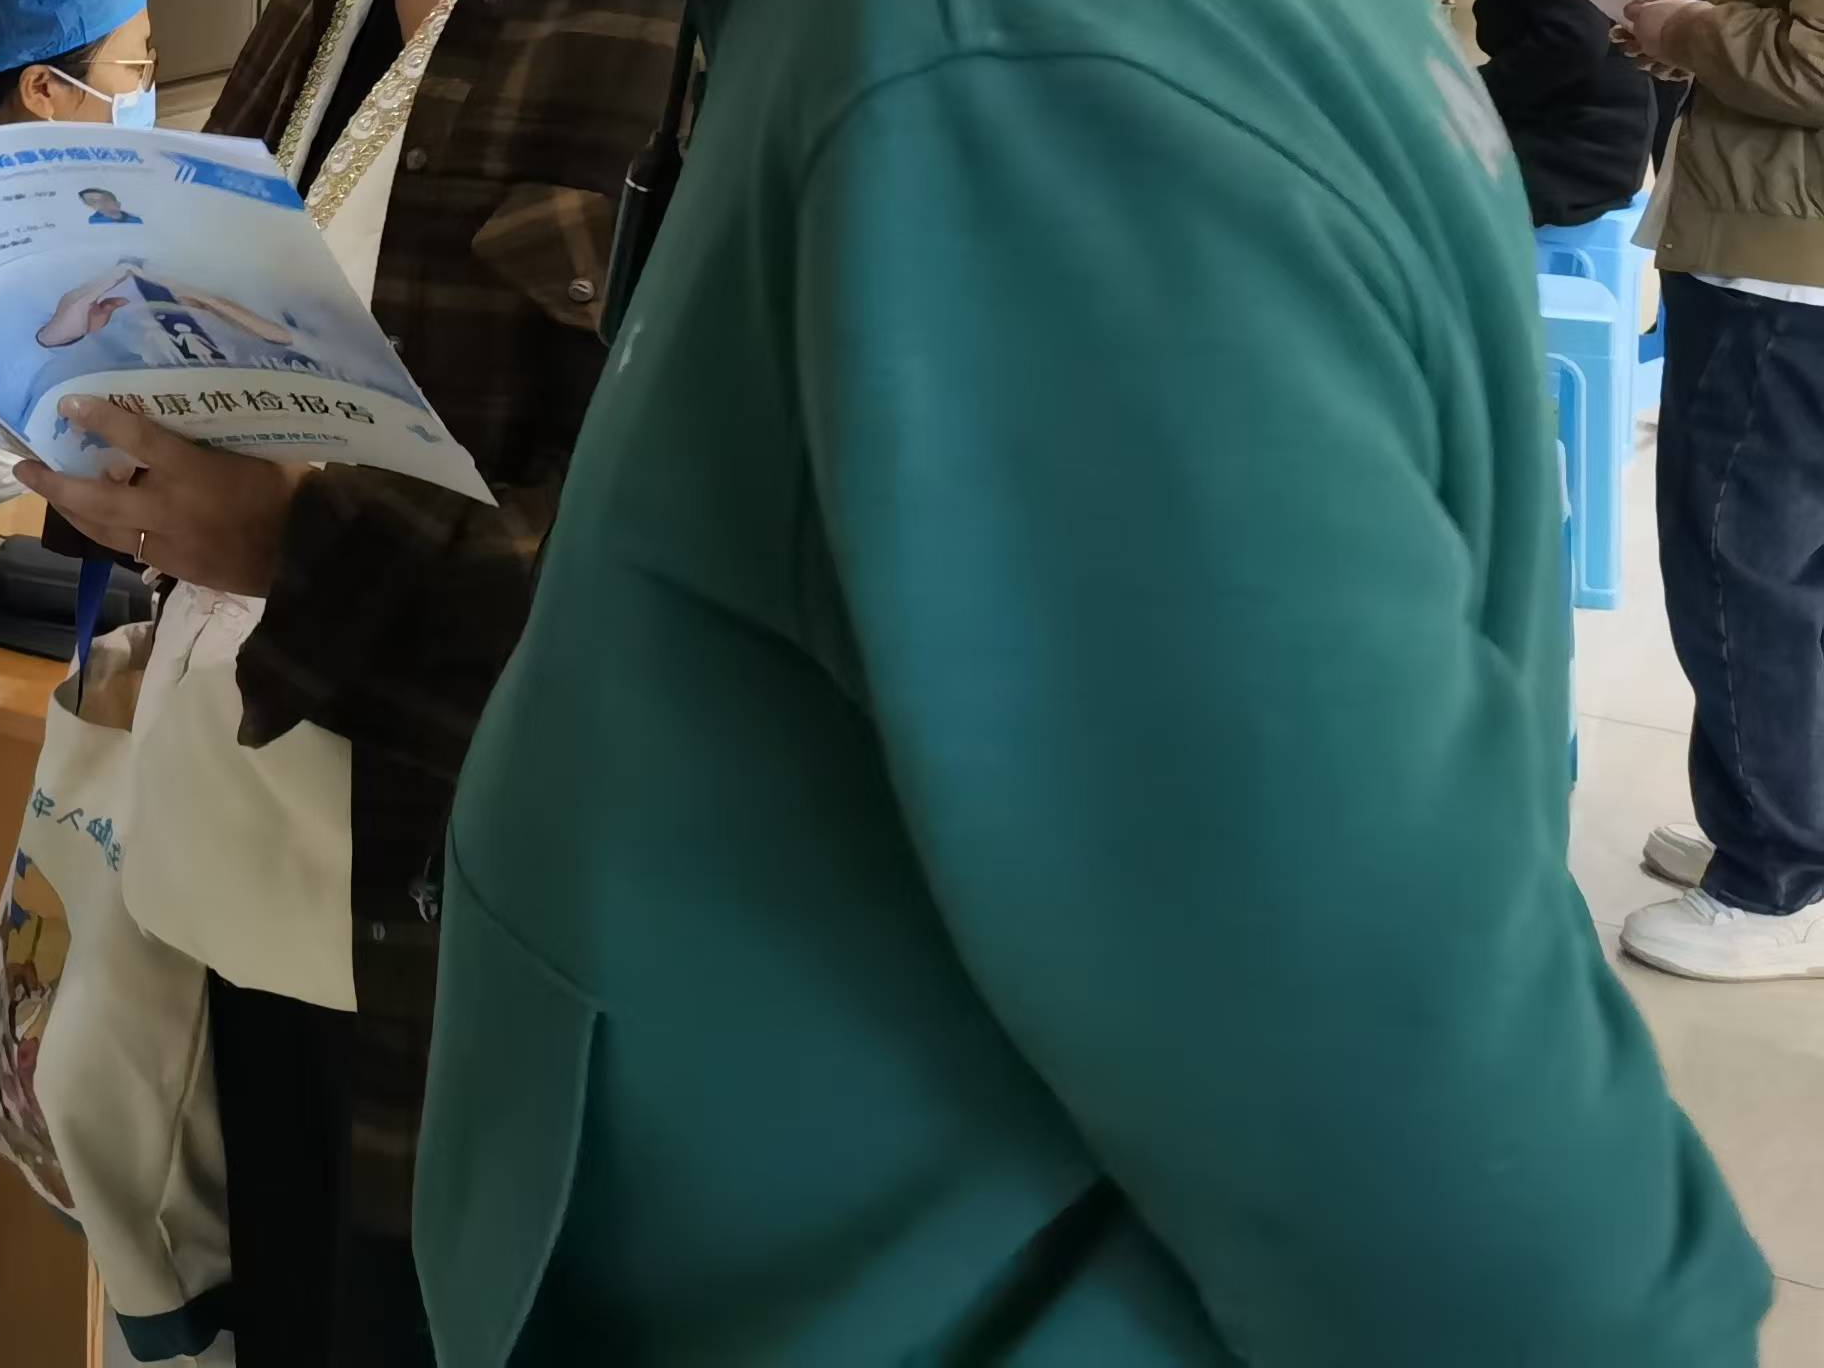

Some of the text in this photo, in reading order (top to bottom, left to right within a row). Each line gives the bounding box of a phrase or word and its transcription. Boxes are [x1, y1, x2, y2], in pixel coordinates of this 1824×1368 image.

[108, 389, 375, 424] 健康体检报告
